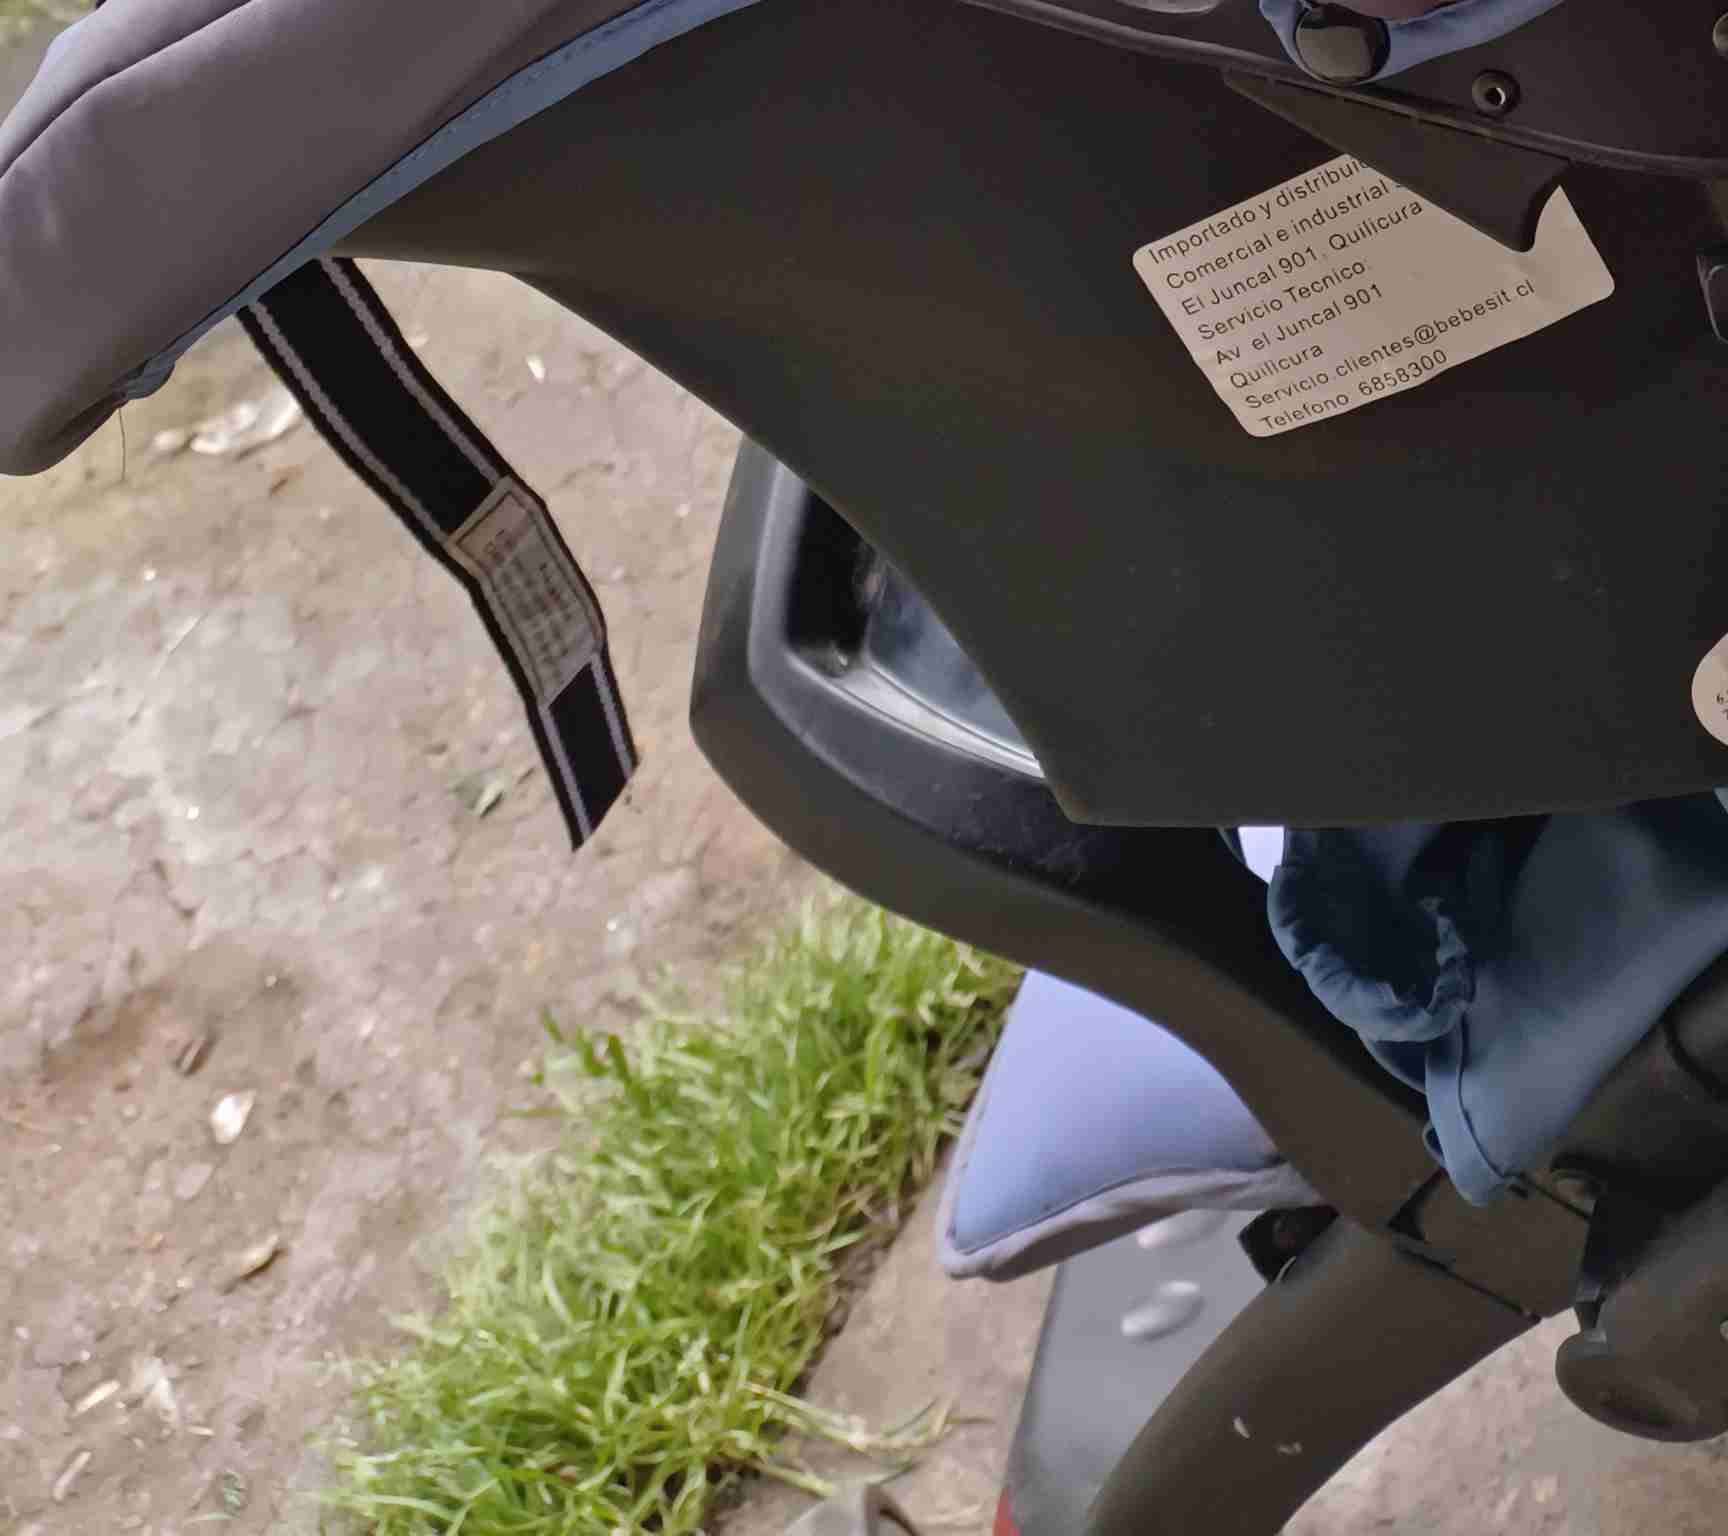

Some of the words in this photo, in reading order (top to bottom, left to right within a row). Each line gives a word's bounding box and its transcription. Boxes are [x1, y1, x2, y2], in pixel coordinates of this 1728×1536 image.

[1148, 209, 1257, 265] Importado
[1258, 201, 1272, 220] y
[1166, 231, 1273, 289] Comercial
[1276, 228, 1290, 242] e
[1290, 179, 1390, 235] industrial
[1181, 295, 1206, 316] El
[1211, 263, 1278, 305] Juncal
[1328, 201, 1423, 251] Quilicura
[1197, 298, 1284, 340] Servicio
[1251, 331, 1271, 351] el
[1276, 300, 1342, 342] Juncal
[1343, 283, 1382, 311] 901
[1229, 344, 1325, 389] Quilicura
[1358, 349, 1448, 396] 6858300
